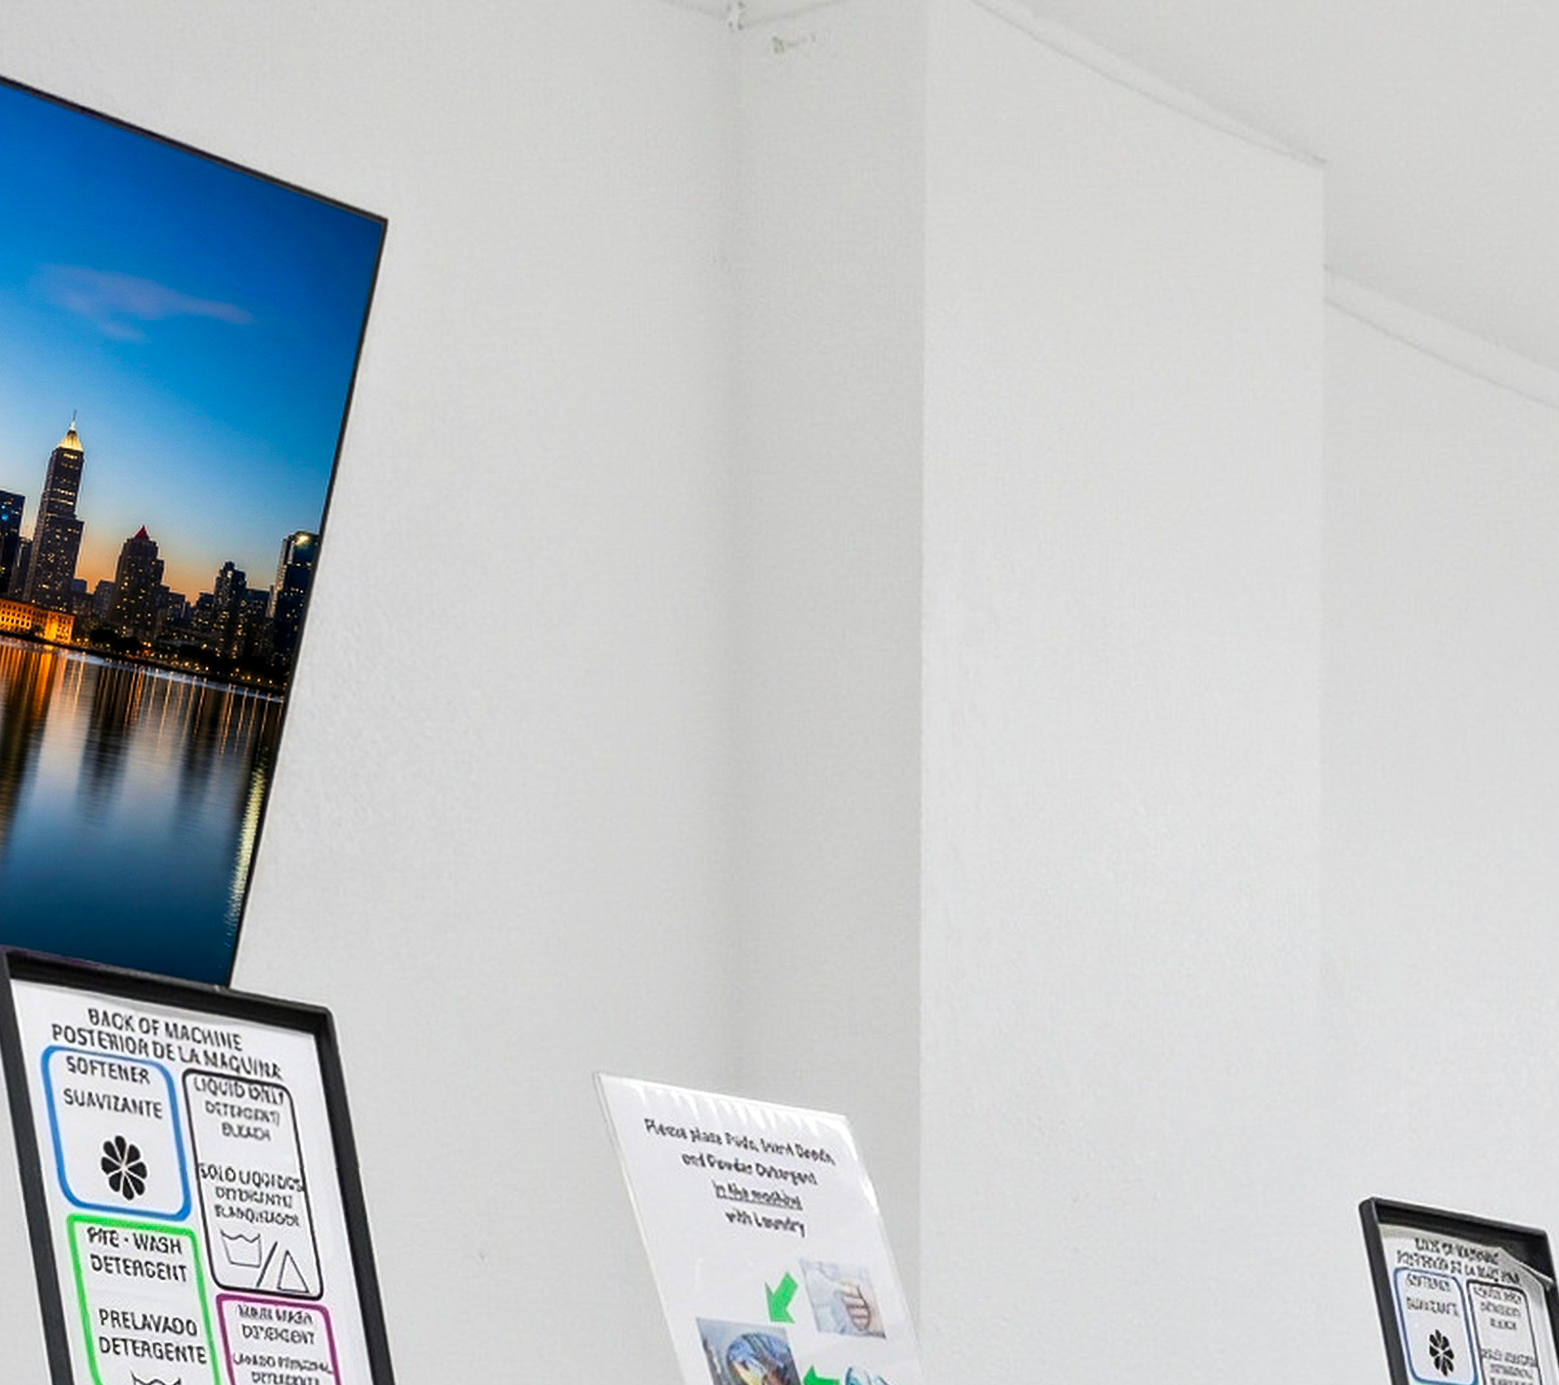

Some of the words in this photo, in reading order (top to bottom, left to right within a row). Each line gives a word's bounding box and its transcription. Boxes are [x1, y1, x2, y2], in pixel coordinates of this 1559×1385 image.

[52, 1024, 149, 1059] POSTERIOR
[153, 1041, 176, 1062] DE
[178, 1045, 199, 1064] LA
[88, 1008, 134, 1033] BACK
[140, 1018, 159, 1035] OF
[164, 1022, 243, 1051] MACHINE
[66, 1055, 151, 1084] SOFTENER
[194, 1077, 245, 1099] LIQUID
[63, 1088, 163, 1119] SUAVIZANTE
[134, 1232, 183, 1255] WASH
[90, 1254, 188, 1283] DETERGENT
[99, 1308, 198, 1337] PRELAVADO
[99, 1336, 208, 1364] DETERGENTE
